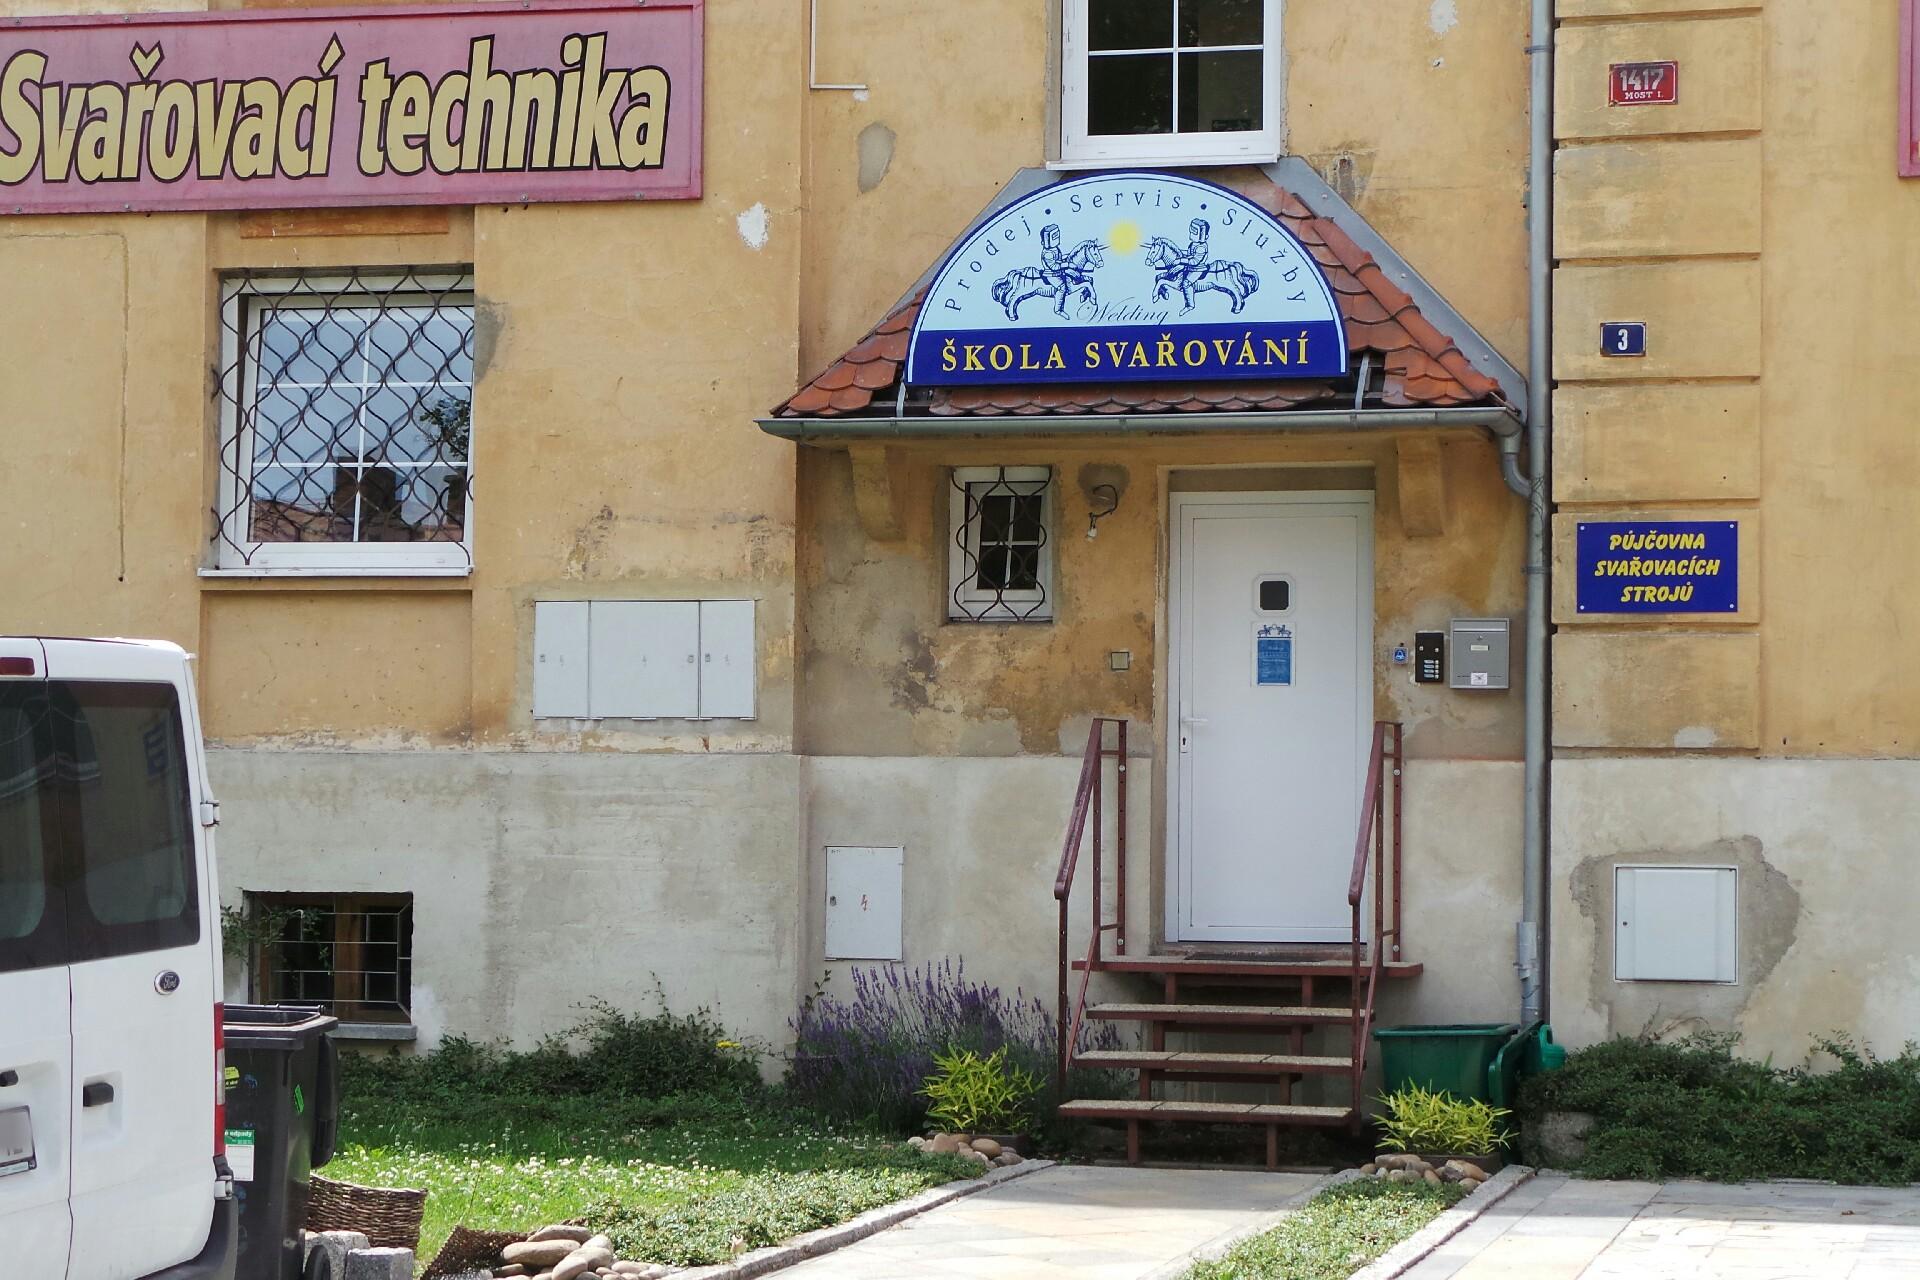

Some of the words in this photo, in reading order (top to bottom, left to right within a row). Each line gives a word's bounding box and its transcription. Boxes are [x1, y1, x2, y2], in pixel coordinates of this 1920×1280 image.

[1620, 68, 1664, 91] 1417
[1624, 91, 1653, 100] MOST
[0, 33, 345, 184] Svařovací
[358, 31, 671, 176] technika
[944, 214, 1031, 312] Prodej
[1070, 189, 1182, 213] Servis
[1222, 207, 1306, 304] Služby
[1077, 297, 1169, 326] Welding
[942, 338, 1066, 372] ŠKOLA
[1085, 330, 1310, 368] SVAŘOVÁNÍ
[1617, 329, 1629, 351] 3
[1594, 555, 1720, 577] SVAŘOVACÍCH
[1621, 581, 1694, 603] STROJŮ
